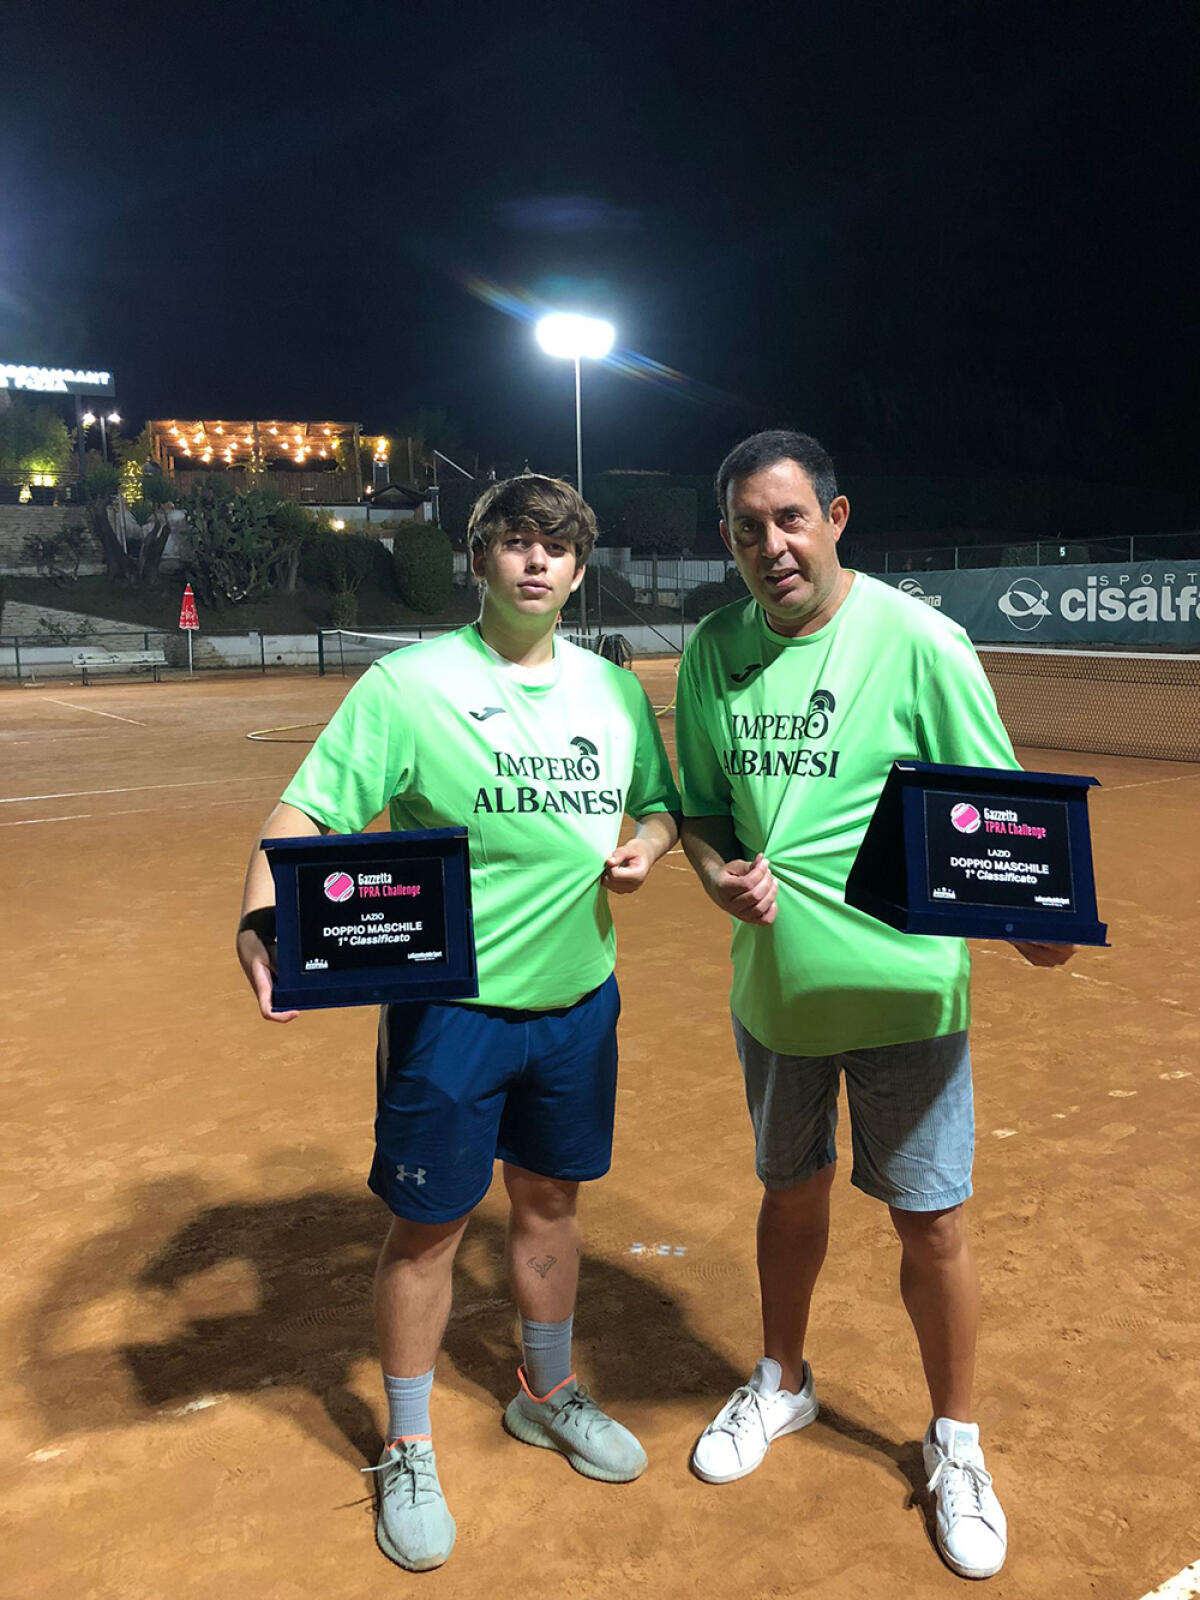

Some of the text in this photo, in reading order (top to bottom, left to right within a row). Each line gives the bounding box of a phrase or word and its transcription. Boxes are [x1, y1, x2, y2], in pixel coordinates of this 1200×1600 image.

[1059, 546, 1067, 557] 5
[1099, 573, 1198, 586] SPORT
[1060, 575, 1200, 622] cisalf
[732, 711, 829, 741] IMPERO
[493, 751, 601, 781] IMPERO
[723, 749, 840, 779] ALBANESI
[473, 786, 623, 815] ALBANESI
[983, 807, 1018, 822] Gazzetta
[984, 821, 1047, 839] TPRA Challenge
[987, 849, 1011, 858] LAZIO
[950, 857, 1050, 874] DOPPIO MASCHILE
[358, 872, 392, 885] Gazzetta
[977, 870, 1038, 884] Classificato
[359, 884, 421, 898] TPRA Challenge
[361, 912, 385, 922] LAZIO
[323, 922, 423, 936] DOPPIO MASCHILE
[350, 934, 411, 946] Classificato
